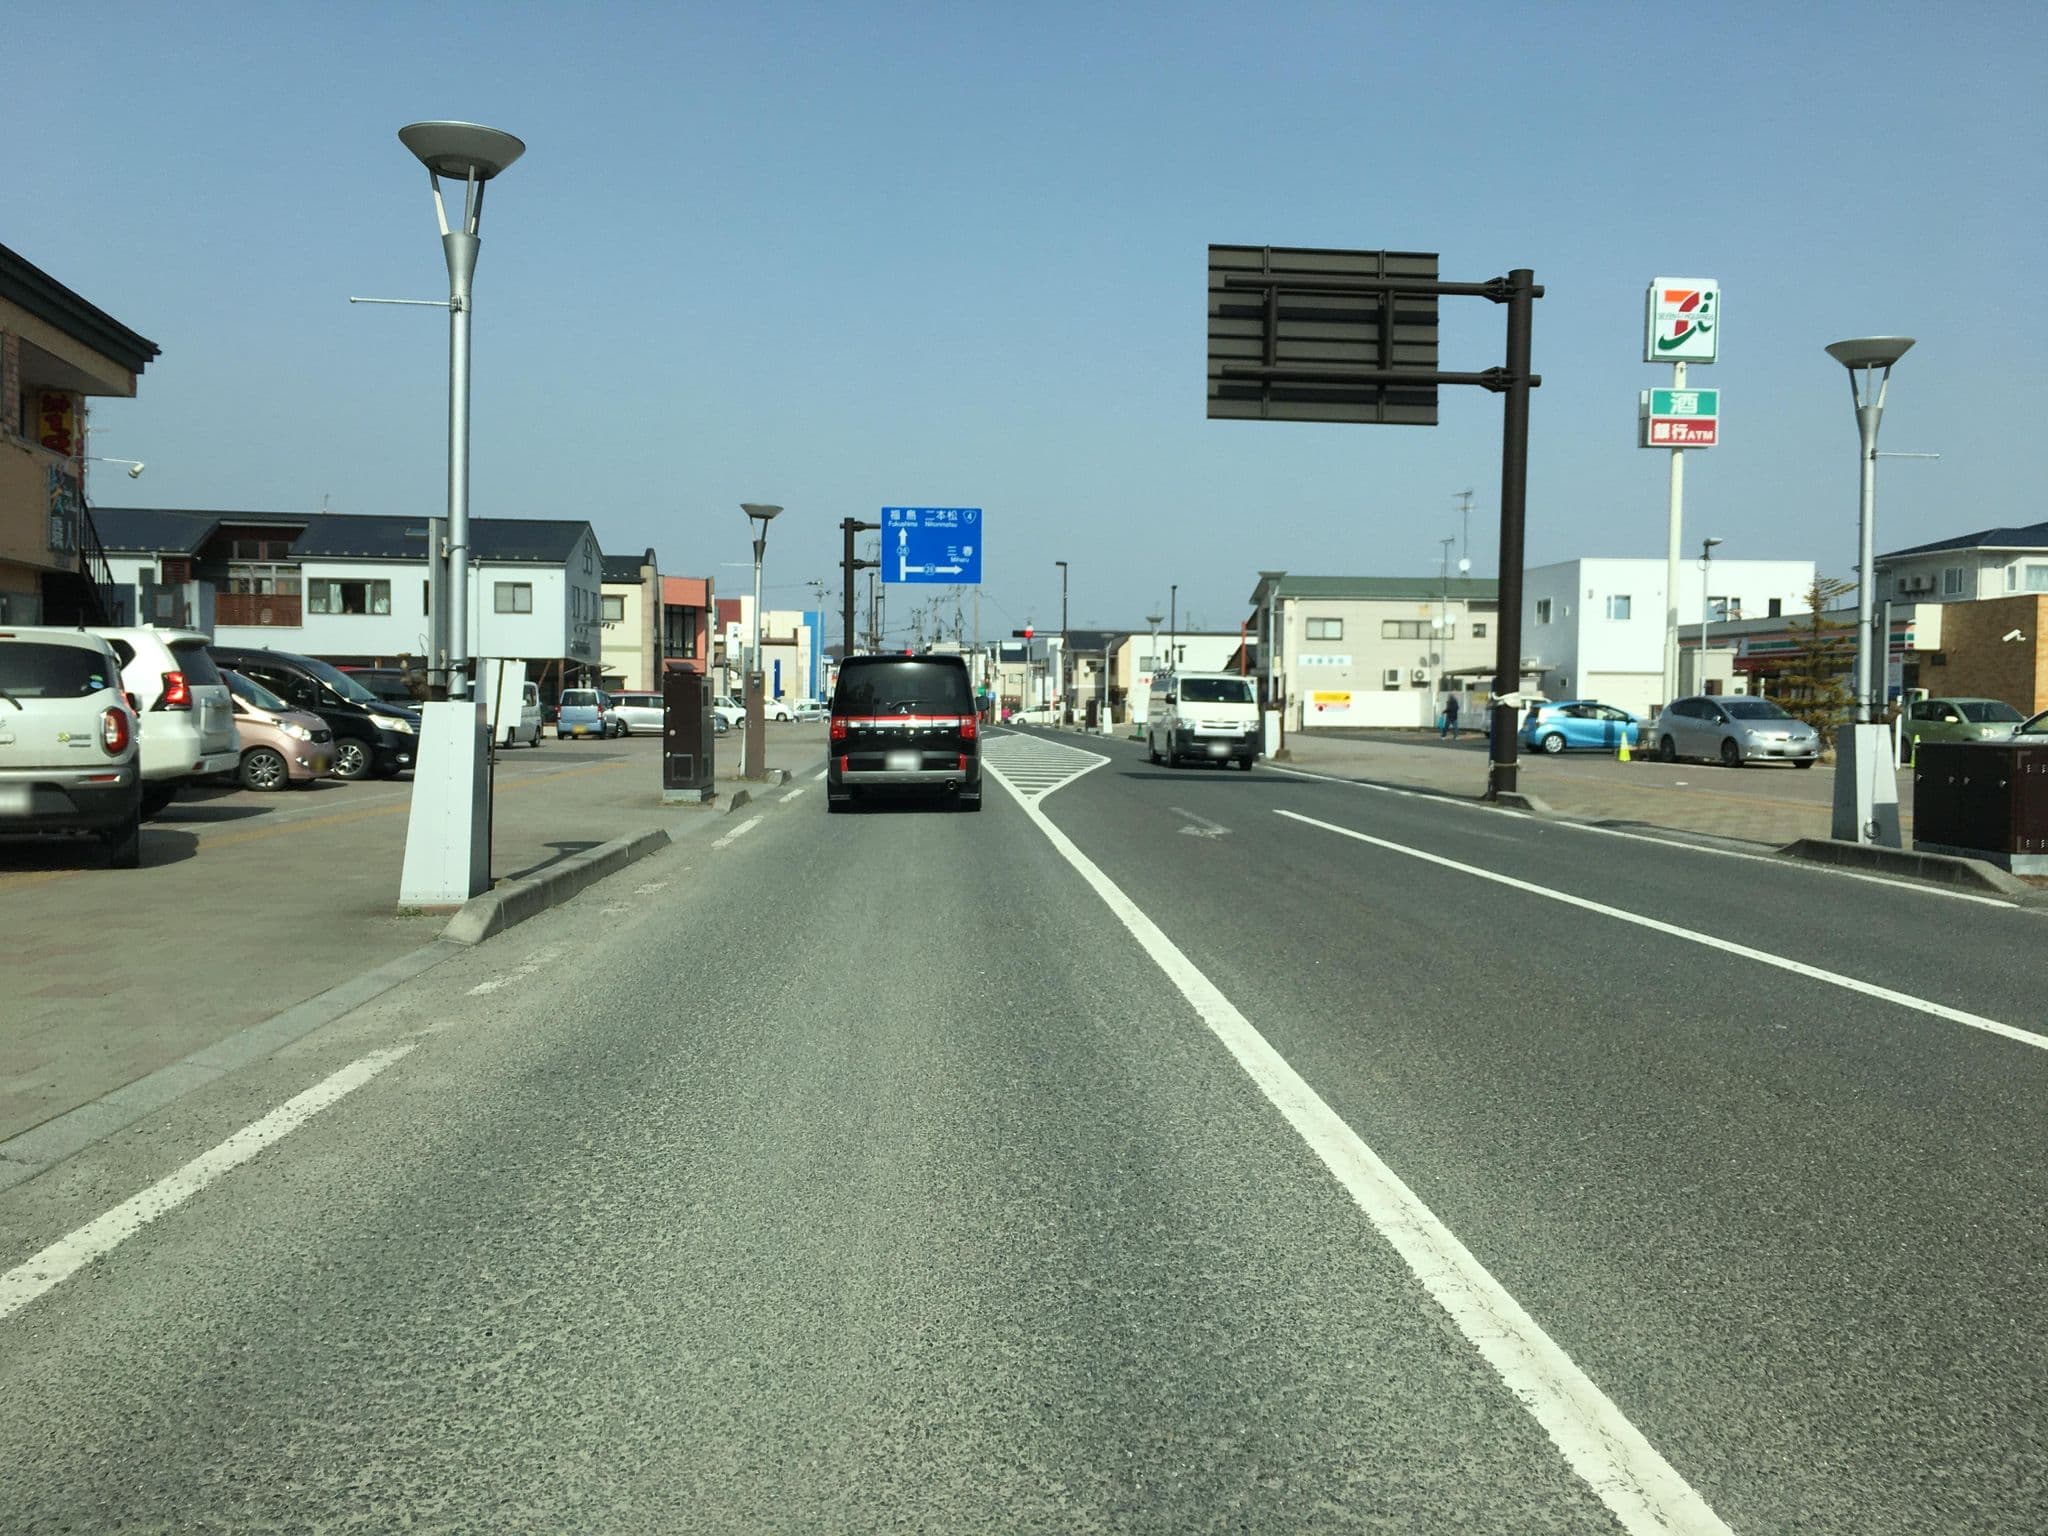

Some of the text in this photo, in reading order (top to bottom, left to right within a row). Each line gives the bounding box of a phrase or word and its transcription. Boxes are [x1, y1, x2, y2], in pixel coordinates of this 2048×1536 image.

[1670, 392, 1699, 414] 酒
[925, 510, 958, 521] 二本松
